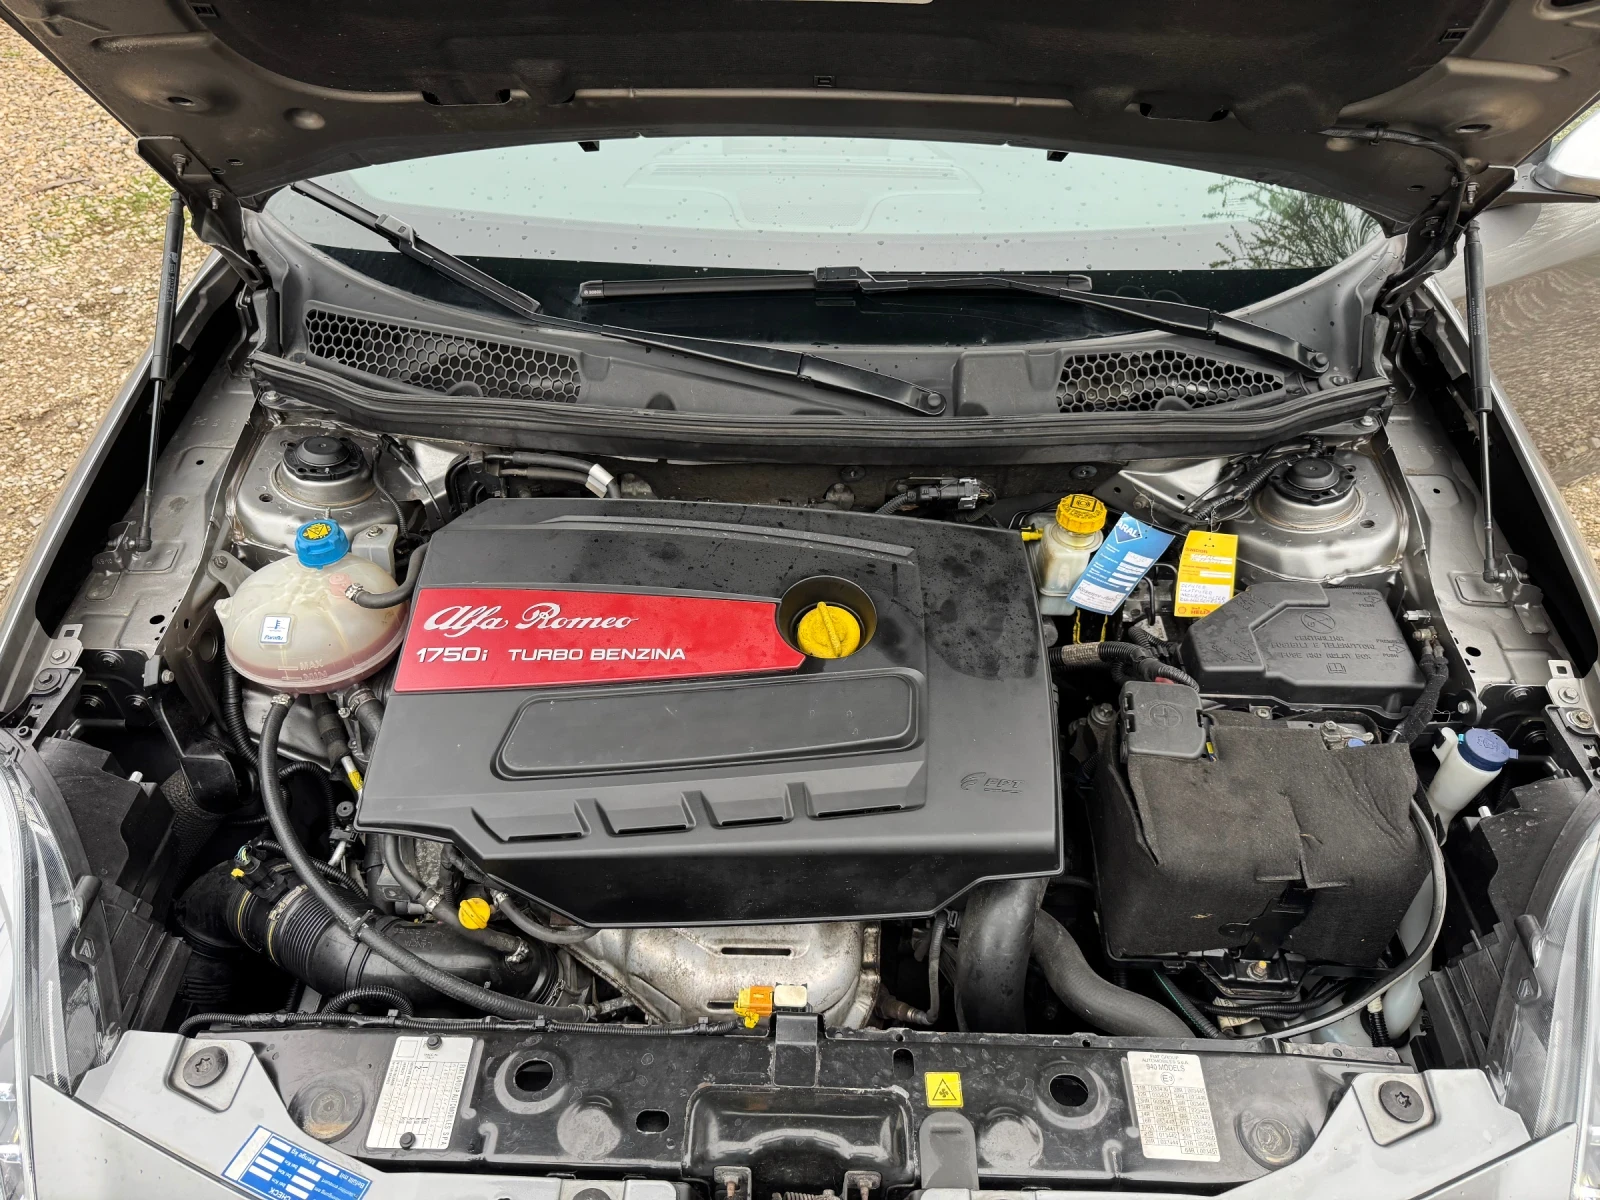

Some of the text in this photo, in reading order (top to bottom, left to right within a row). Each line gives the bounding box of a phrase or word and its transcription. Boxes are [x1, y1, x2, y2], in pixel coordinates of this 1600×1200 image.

[423, 602, 639, 638] Alfa Romeo
[416, 647, 686, 663] 1750i TURBO BENZINA
[300, 659, 323, 670] MAX
[457, 1063, 466, 1074] FIAT
[1158, 1064, 1185, 1072] MODELS
